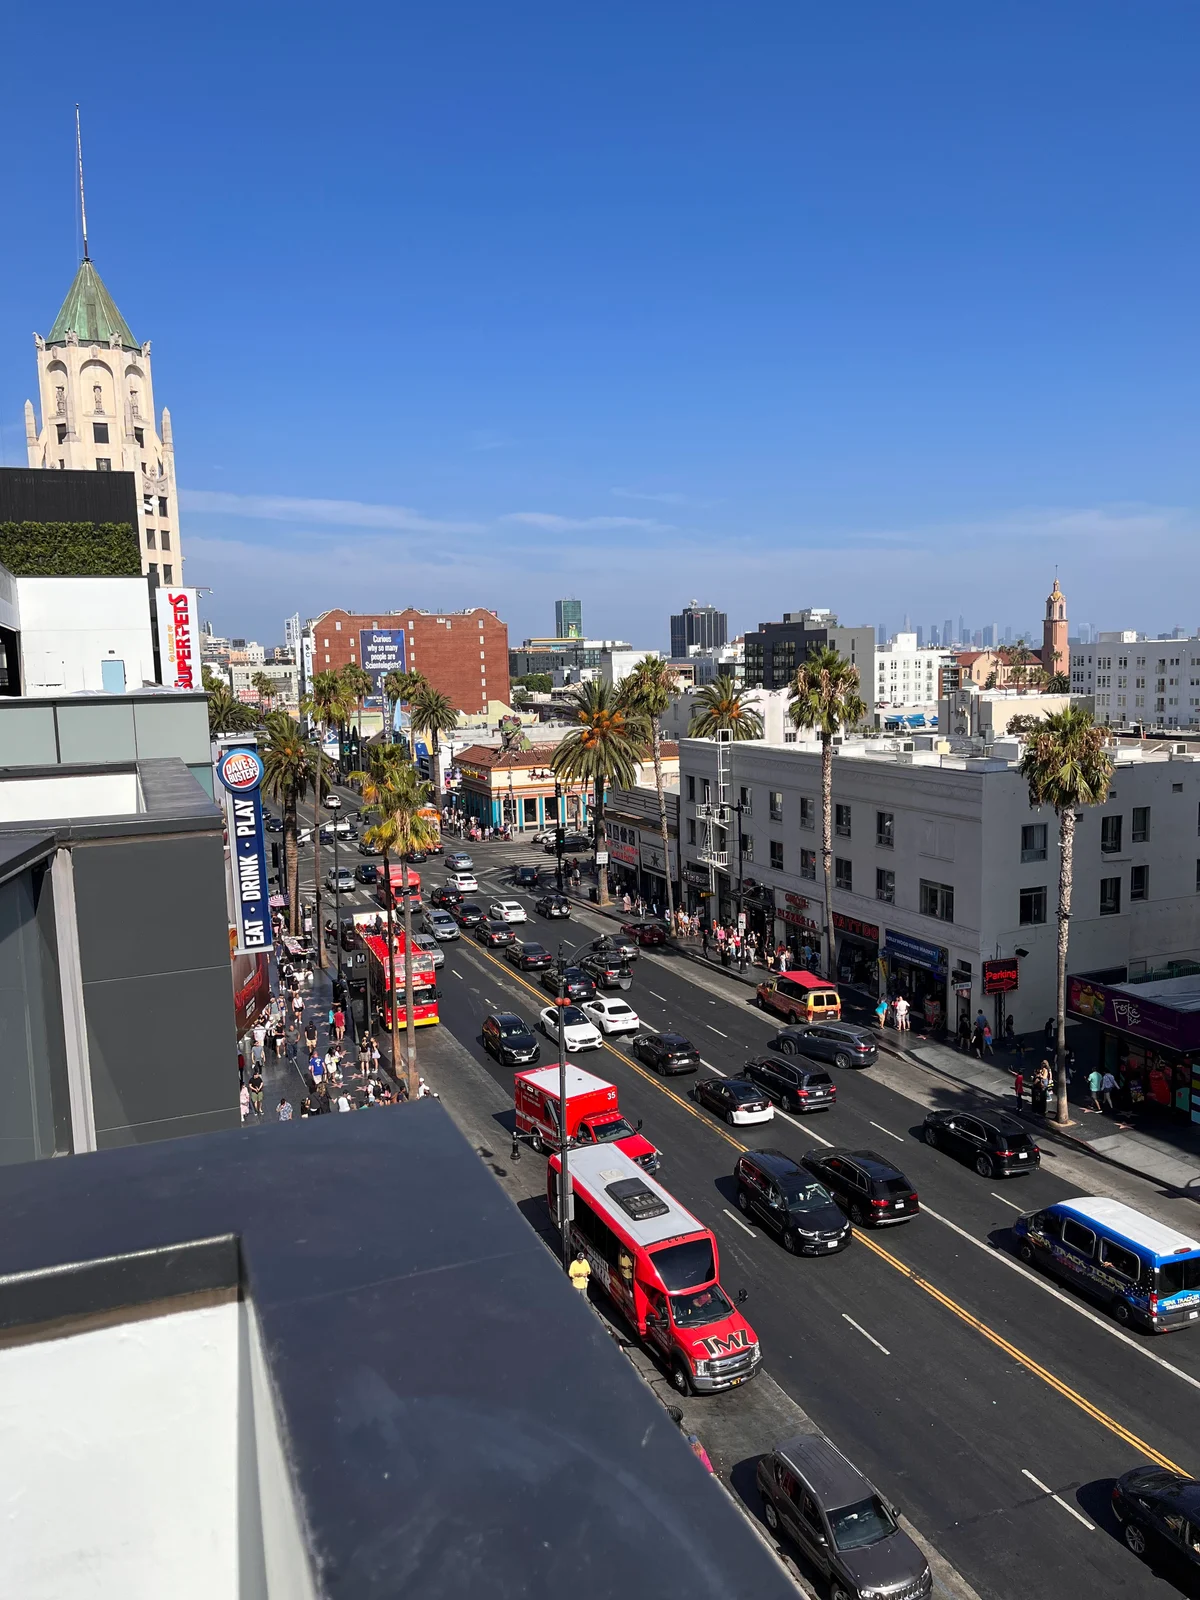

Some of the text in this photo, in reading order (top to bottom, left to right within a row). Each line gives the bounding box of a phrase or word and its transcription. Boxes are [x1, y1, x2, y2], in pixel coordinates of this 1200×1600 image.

[373, 635, 392, 643] Curious
[367, 644, 378, 654] why
[384, 644, 399, 653] many
[370, 652, 396, 663] people are
[365, 660, 402, 670] Scientologists?
[228, 767, 259, 783] BUSTER'S
[234, 798, 256, 837] PLAY
[239, 853, 261, 902] DRINK
[832, 912, 878, 940] TATTOO
[244, 919, 265, 947] EAT
[919, 946, 937, 956] MARKET
[985, 970, 1017, 981] Parking
[607, 1091, 616, 1101] 35
[1028, 1230, 1052, 1250] STAR
[1054, 1244, 1088, 1270] TRACK
[1089, 1264, 1127, 1291] TOURS
[692, 1329, 755, 1358] TMZ
